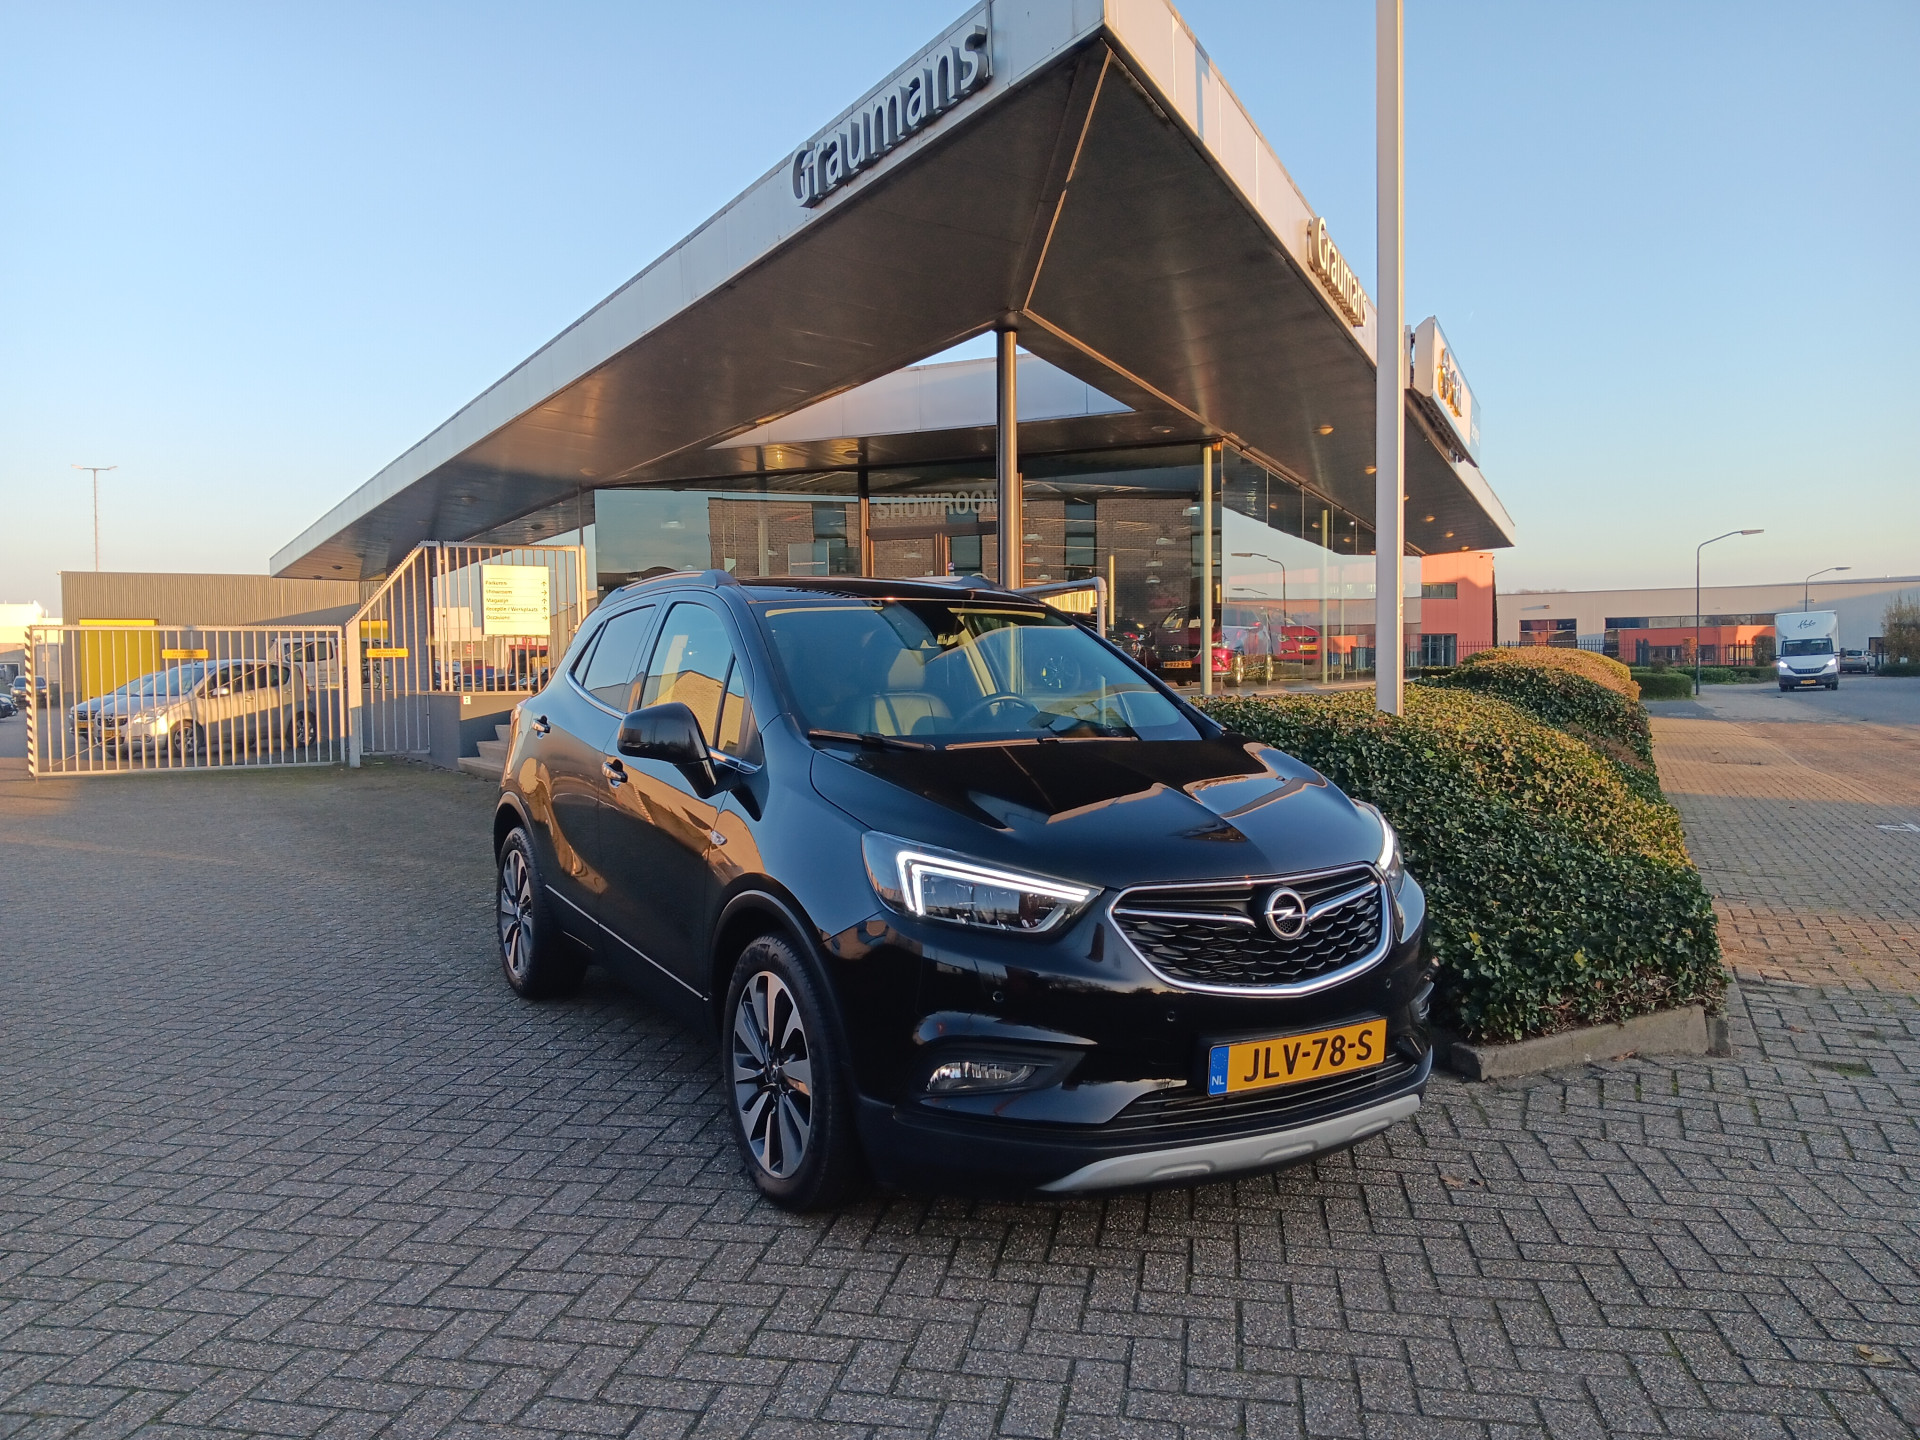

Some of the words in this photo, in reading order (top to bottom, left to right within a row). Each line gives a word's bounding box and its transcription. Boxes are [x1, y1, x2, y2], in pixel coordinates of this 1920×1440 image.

[791, 25, 989, 208] Graumans
[1309, 217, 1367, 327] Graumans
[1211, 1075, 1225, 1086] NL
[1243, 1029, 1373, 1082] JLV-78-S
